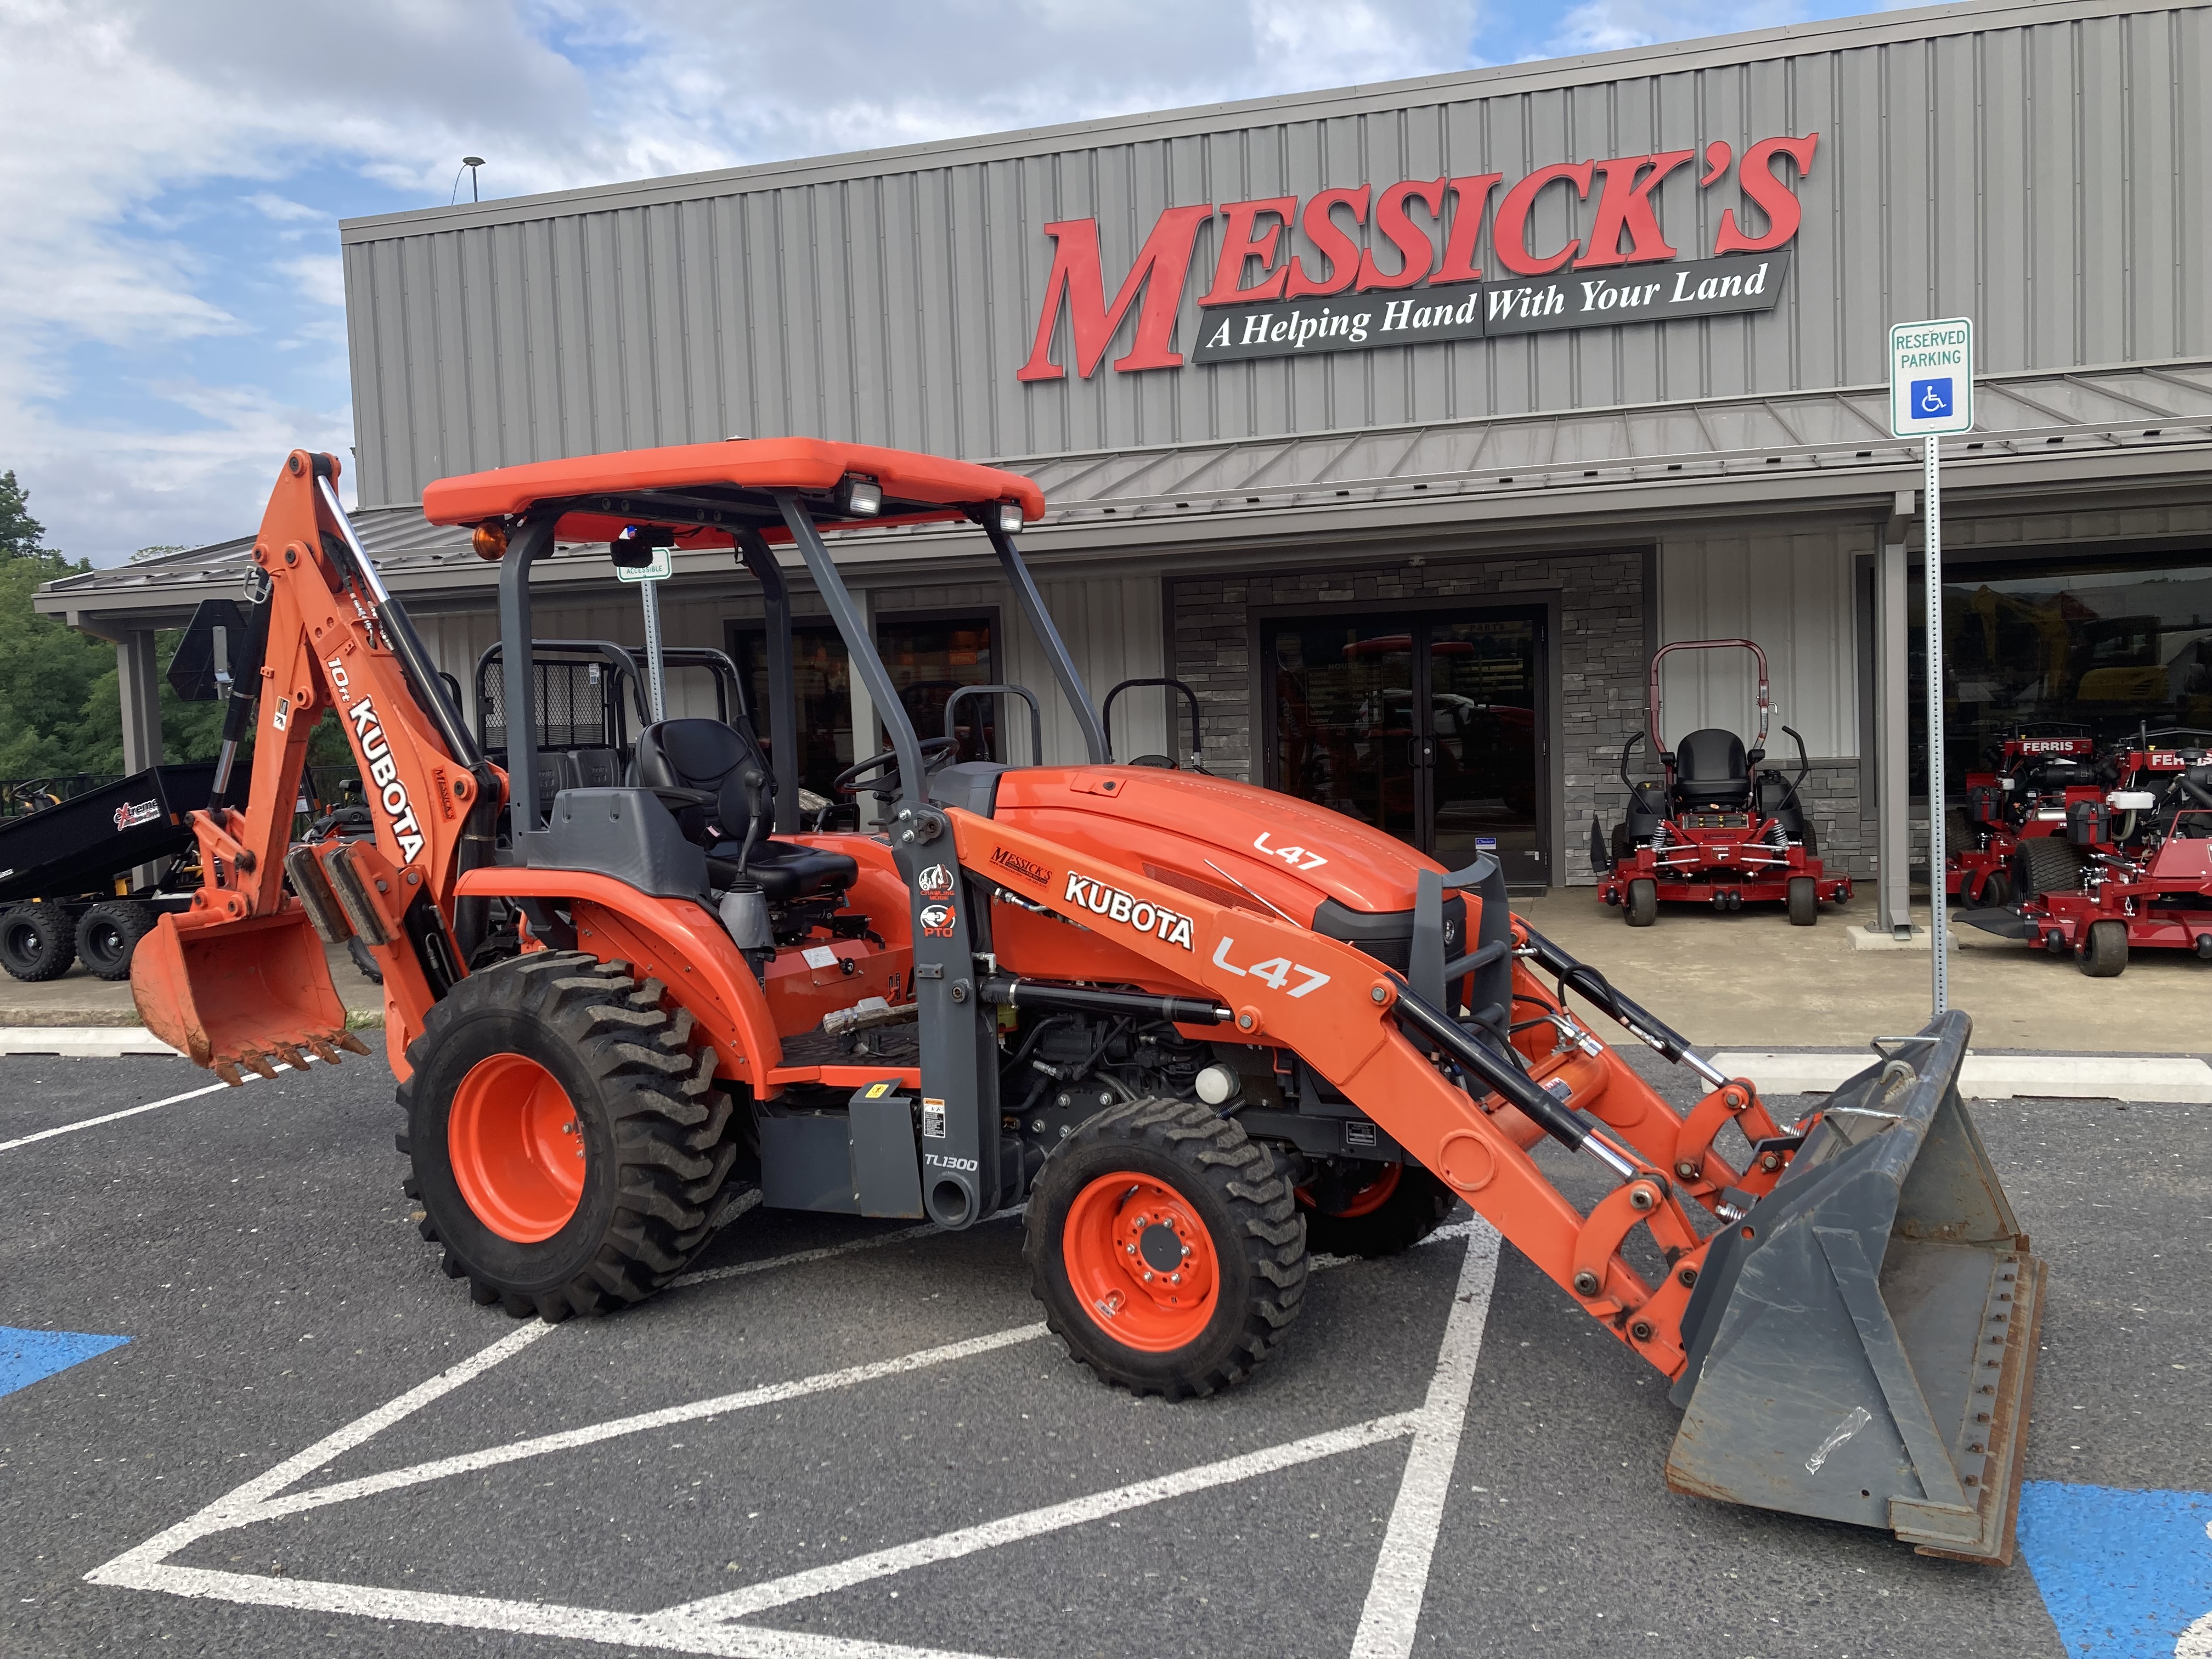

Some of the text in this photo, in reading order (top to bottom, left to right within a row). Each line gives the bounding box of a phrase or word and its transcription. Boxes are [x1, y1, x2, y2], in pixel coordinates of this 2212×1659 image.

[1017, 132, 1819, 382] MESSICK'S
[1205, 262, 1769, 349] A Helping Hand With Your Land
[1896, 330, 1966, 350] RESERVED
[1901, 349, 1961, 369] PARKING
[627, 565, 663, 574] ACCESSIBLE
[2023, 741, 2074, 752] FERRIS
[2152, 753, 2212, 766] FERIS
[349, 696, 426, 865] KUBOTA
[990, 846, 1053, 881] MESSICK'S
[1253, 831, 1328, 871] L47
[1064, 873, 1193, 951] KUBOTA
[924, 927, 953, 938] PTO
[1212, 936, 1331, 998] L47
[924, 1153, 978, 1172] TL1300
